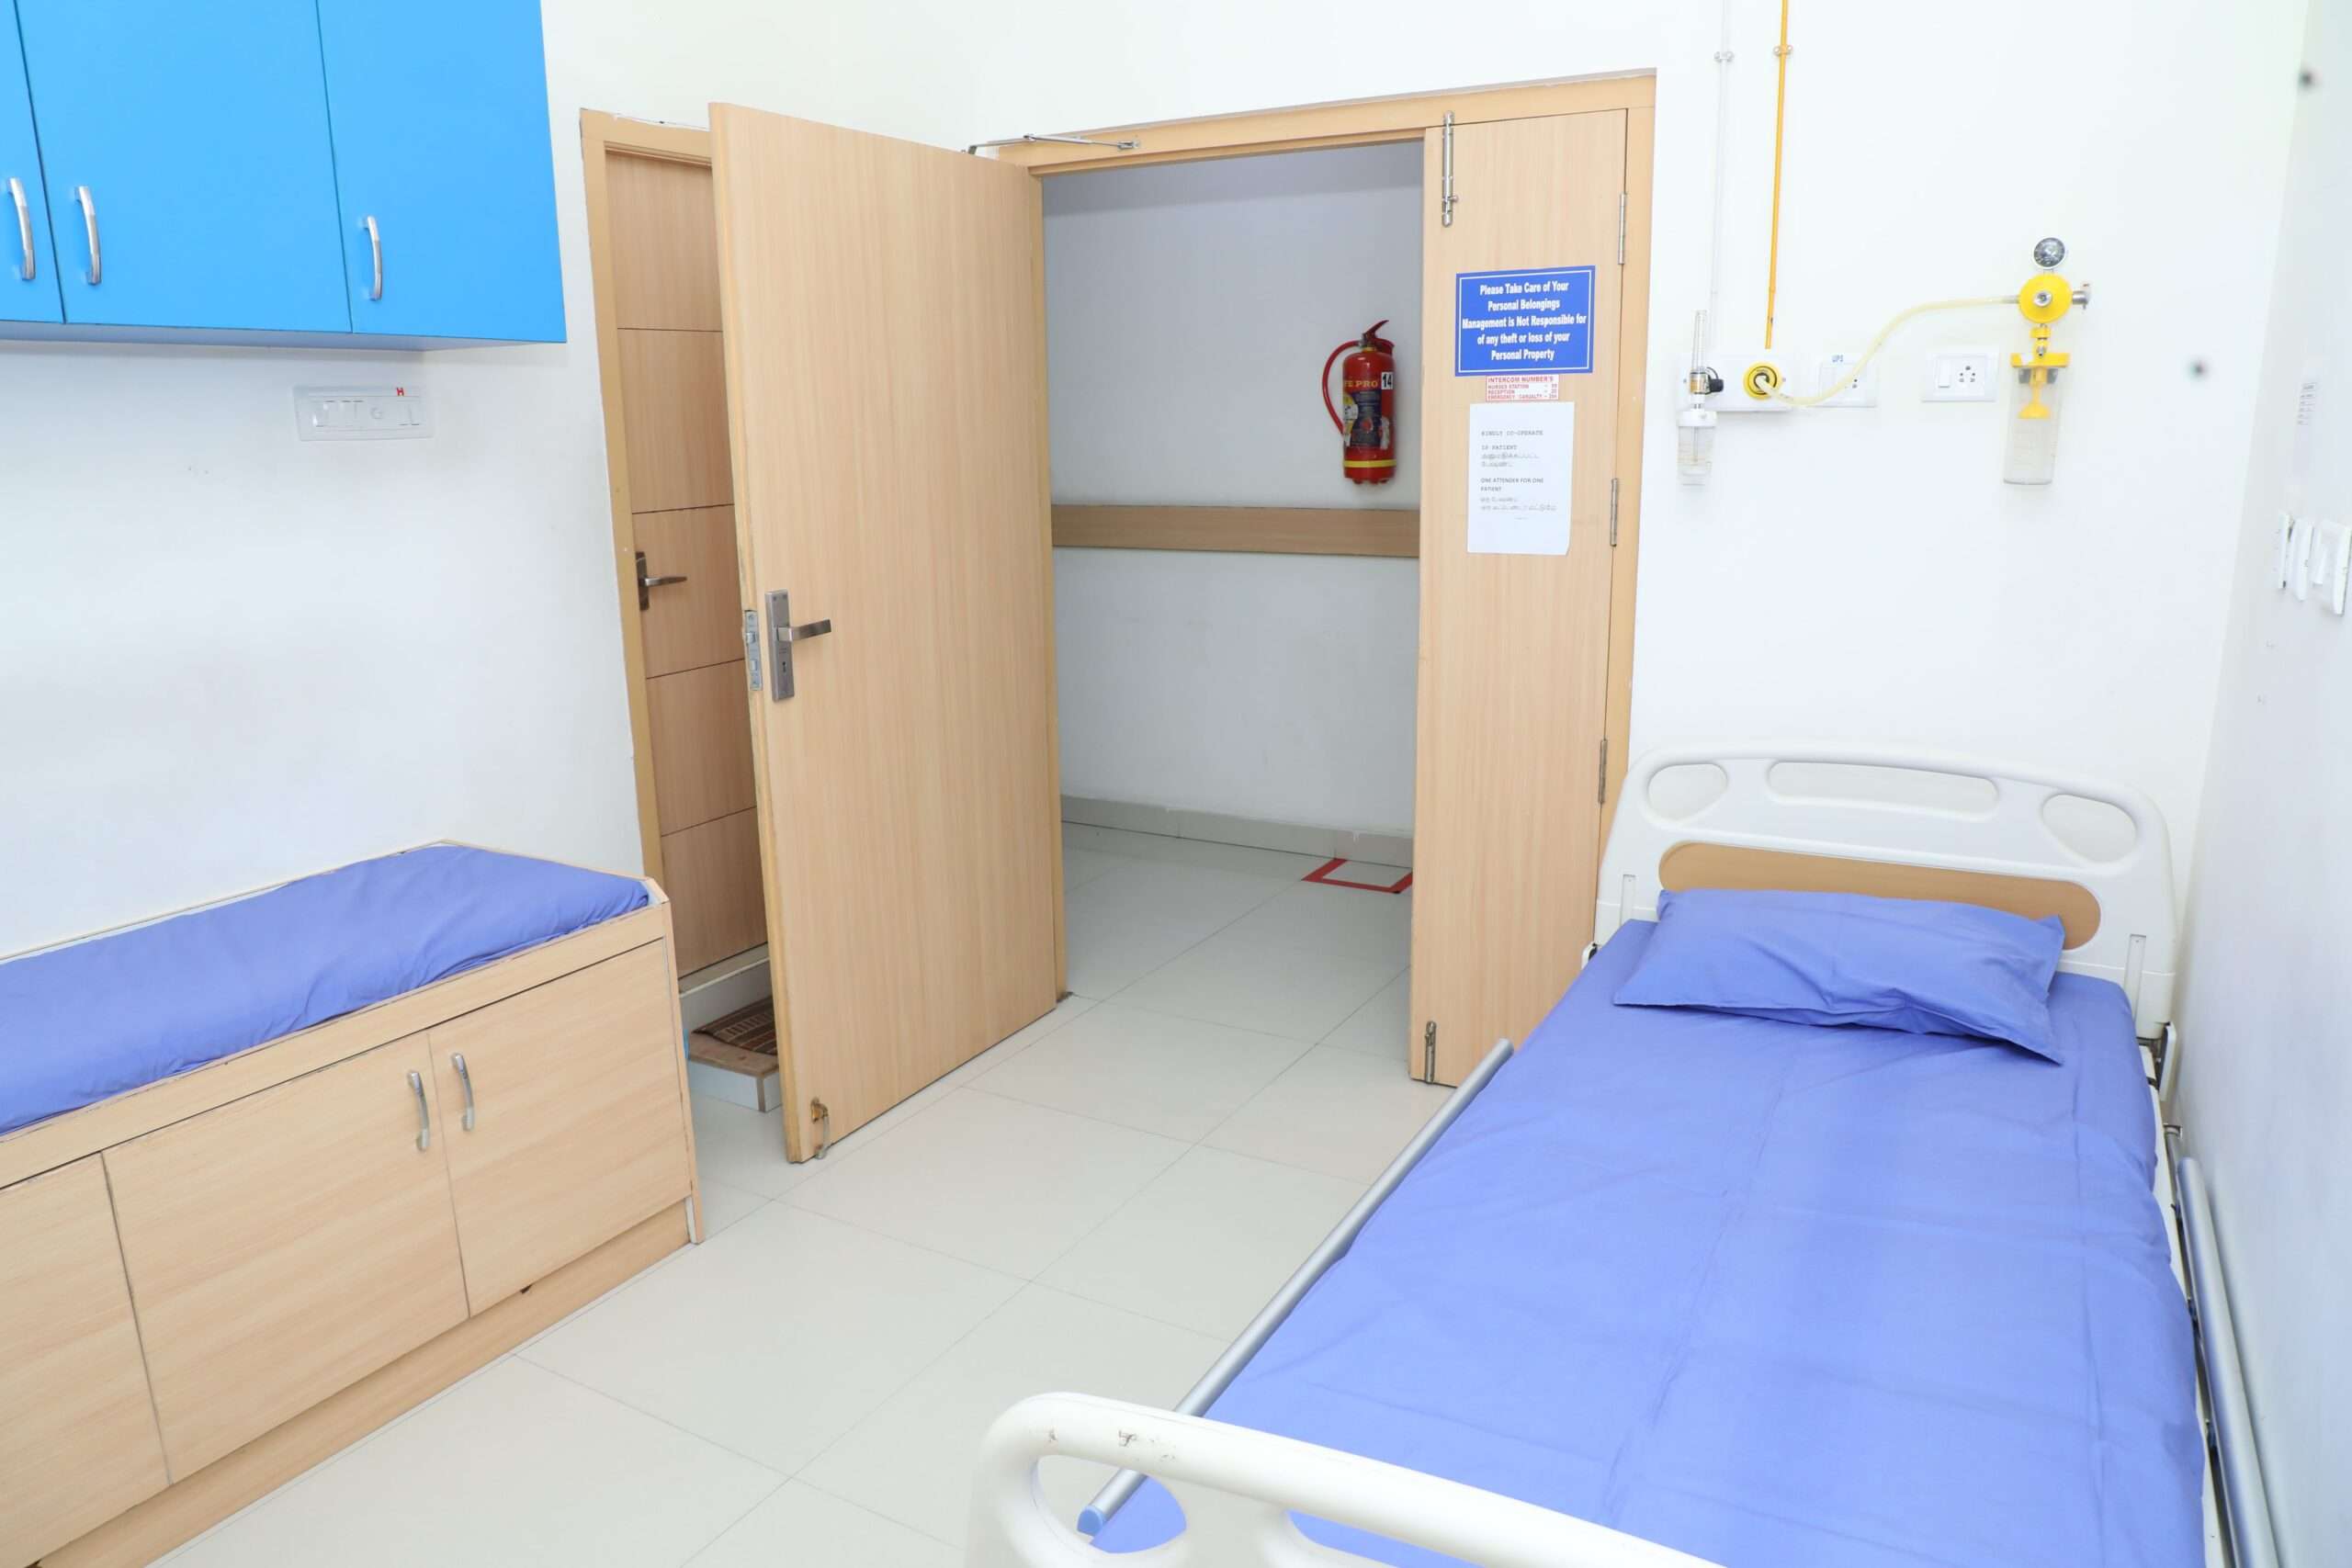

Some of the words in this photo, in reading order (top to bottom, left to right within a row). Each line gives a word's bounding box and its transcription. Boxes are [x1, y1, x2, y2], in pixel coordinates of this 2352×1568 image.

[1480, 285, 1504, 295] Please
[1505, 283, 1522, 294] Take
[1524, 282, 1541, 293] Care
[1543, 282, 1551, 292] of
[1551, 280, 1569, 291] Your
[1487, 299, 1519, 311] Personal
[1521, 299, 1560, 311] Belongings
[1462, 318, 1507, 330] Management
[1509, 317, 1515, 327] is
[1516, 316, 1529, 327] Not
[1531, 314, 1574, 327] Responsible
[1576, 313, 1587, 323] for
[1477, 334, 1485, 344] of
[1486, 335, 1498, 346] any
[1500, 333, 1517, 344] theft
[1519, 334, 1527, 343] or
[1529, 333, 1543, 343] loss
[1544, 332, 1553, 342] of
[1554, 332, 1570, 344] your
[1491, 350, 1521, 361] Personal
[1523, 348, 1555, 361] Property
[1382, 373, 1392, 388] 14
[396, 385, 405, 396] H
